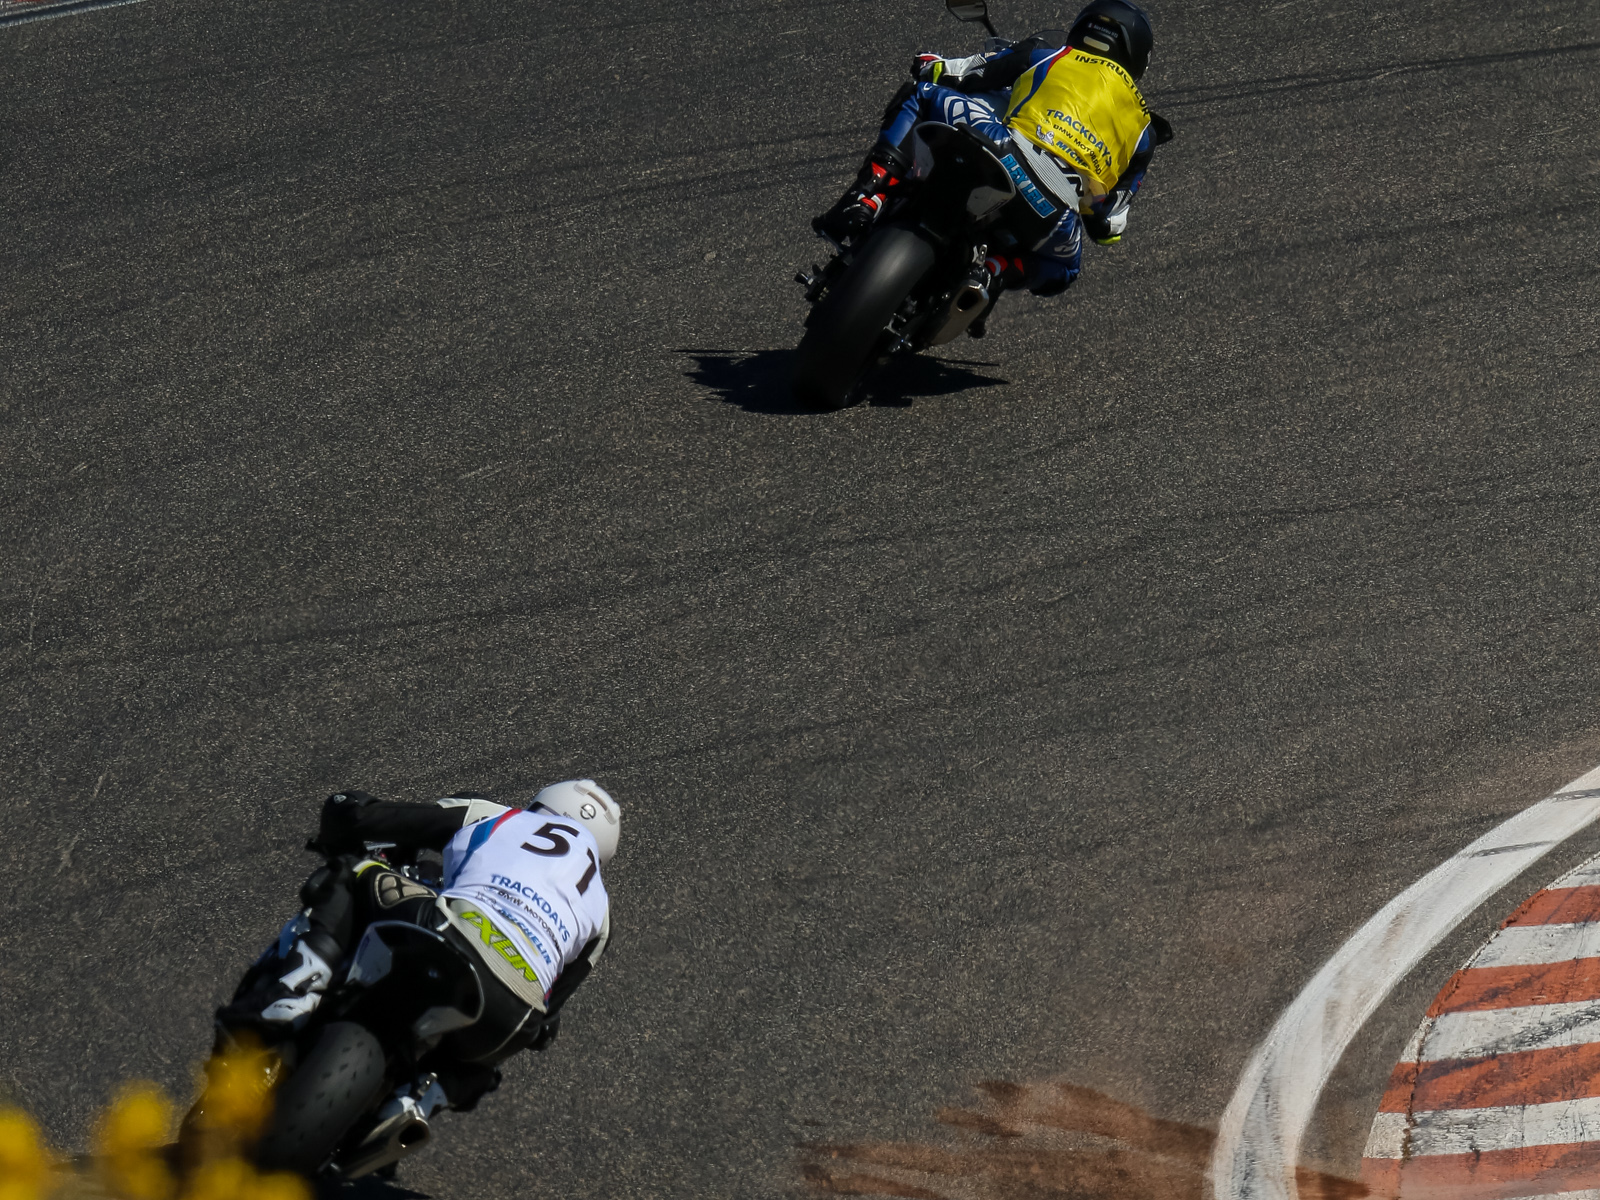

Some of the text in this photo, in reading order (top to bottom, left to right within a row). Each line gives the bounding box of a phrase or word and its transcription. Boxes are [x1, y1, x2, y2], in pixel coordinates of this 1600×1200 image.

[1074, 54, 1150, 118] INSTRUCTEUR
[1047, 108, 1112, 168] TRACKDAYS
[1053, 123, 1102, 175] BMW MOTORRAD
[520, 822, 597, 896] 51
[490, 873, 571, 943] TRACKDAYS
